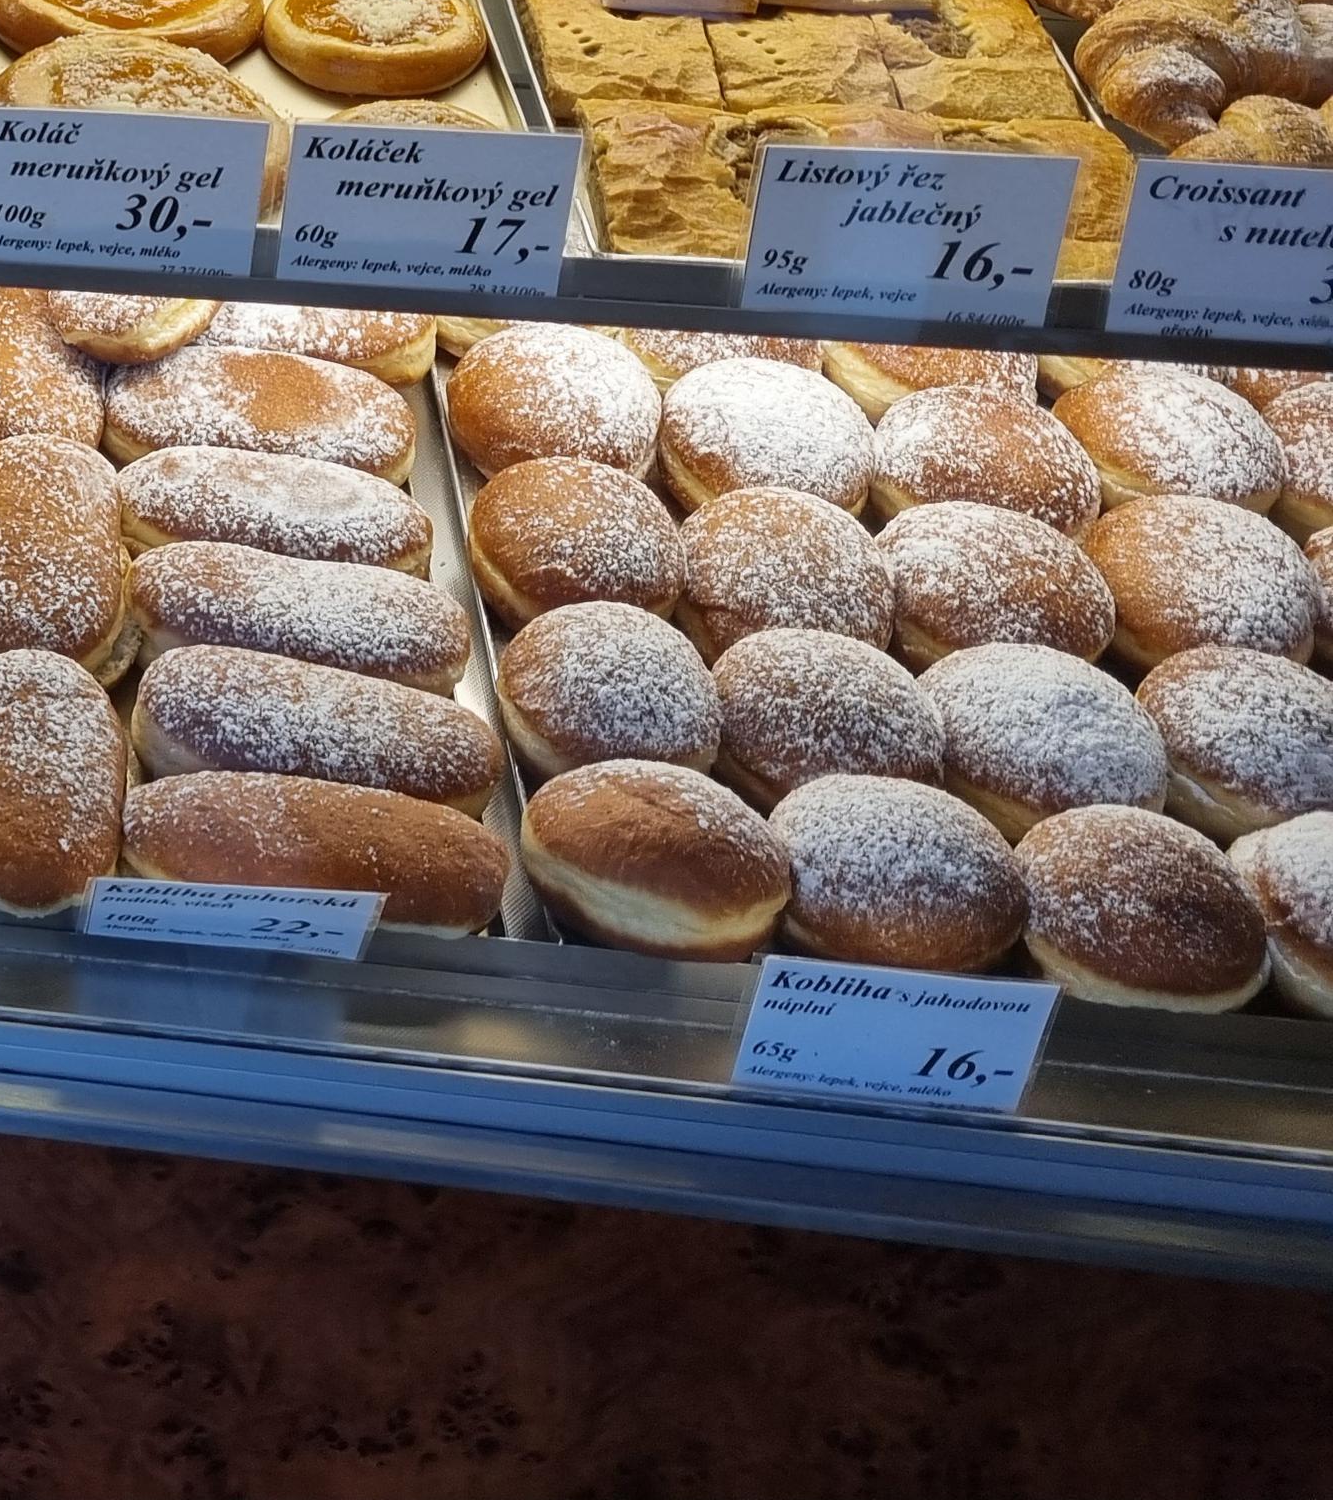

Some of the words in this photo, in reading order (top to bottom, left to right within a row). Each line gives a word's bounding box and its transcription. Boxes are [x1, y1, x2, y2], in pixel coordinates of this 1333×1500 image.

[303, 136, 425, 164] Koláček
[9, 158, 171, 190] meruňkový
[175, 167, 224, 193] gel
[775, 158, 890, 192] Listový
[897, 164, 948, 191] řez
[1149, 175, 1306, 208] Croissant
[335, 176, 503, 210] meruňkový
[507, 184, 560, 212] gel
[115, 194, 213, 242] 30,-
[840, 198, 982, 233] jablečný
[55, 238, 95, 254] lepek,
[99, 244, 135, 256] vejce,
[139, 246, 181, 259] mléko
[295, 224, 339, 248] 60g
[455, 216, 549, 265] 17,-
[1218, 224, 1236, 243] s
[762, 248, 809, 276] 95g
[926, 240, 1034, 291] 16,-
[1128, 268, 1178, 297] 80g
[105, 883, 217, 900] Kobliha
[221, 891, 359, 909] pohorská
[103, 913, 158, 925] 100g
[251, 917, 345, 938] 22,-
[762, 998, 838, 1017] náplní
[768, 970, 894, 1001] Kobliha
[899, 990, 911, 1003] s
[909, 990, 1033, 1013] jahodovou
[752, 1039, 799, 1063] 65g
[911, 1047, 1014, 1088] 16,-
